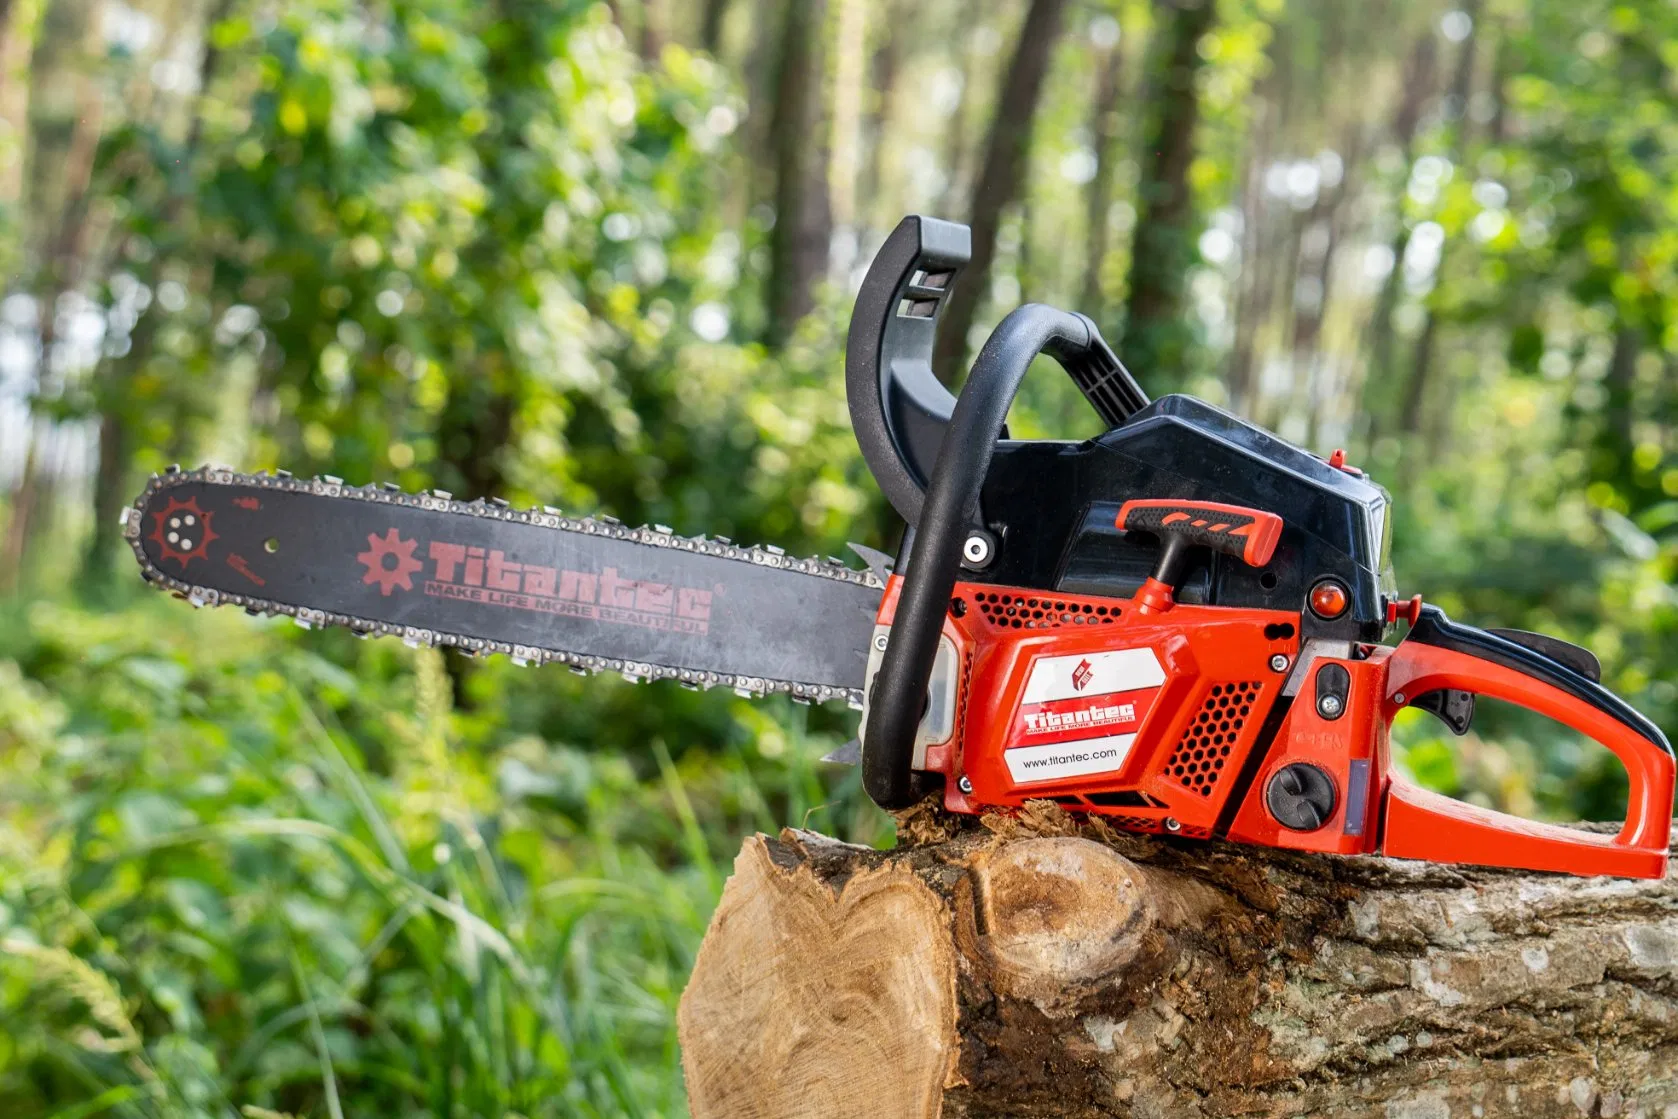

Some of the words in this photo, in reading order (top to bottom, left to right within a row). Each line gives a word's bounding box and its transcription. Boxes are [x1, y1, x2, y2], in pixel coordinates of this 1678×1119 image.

[428, 541, 712, 620] Titantec
[426, 582, 482, 602] MAKE
[487, 589, 529, 608] LIFE
[535, 599, 592, 618] MORE
[1024, 704, 1135, 729] Titantec
[1023, 748, 1117, 769] www.titantec.com
